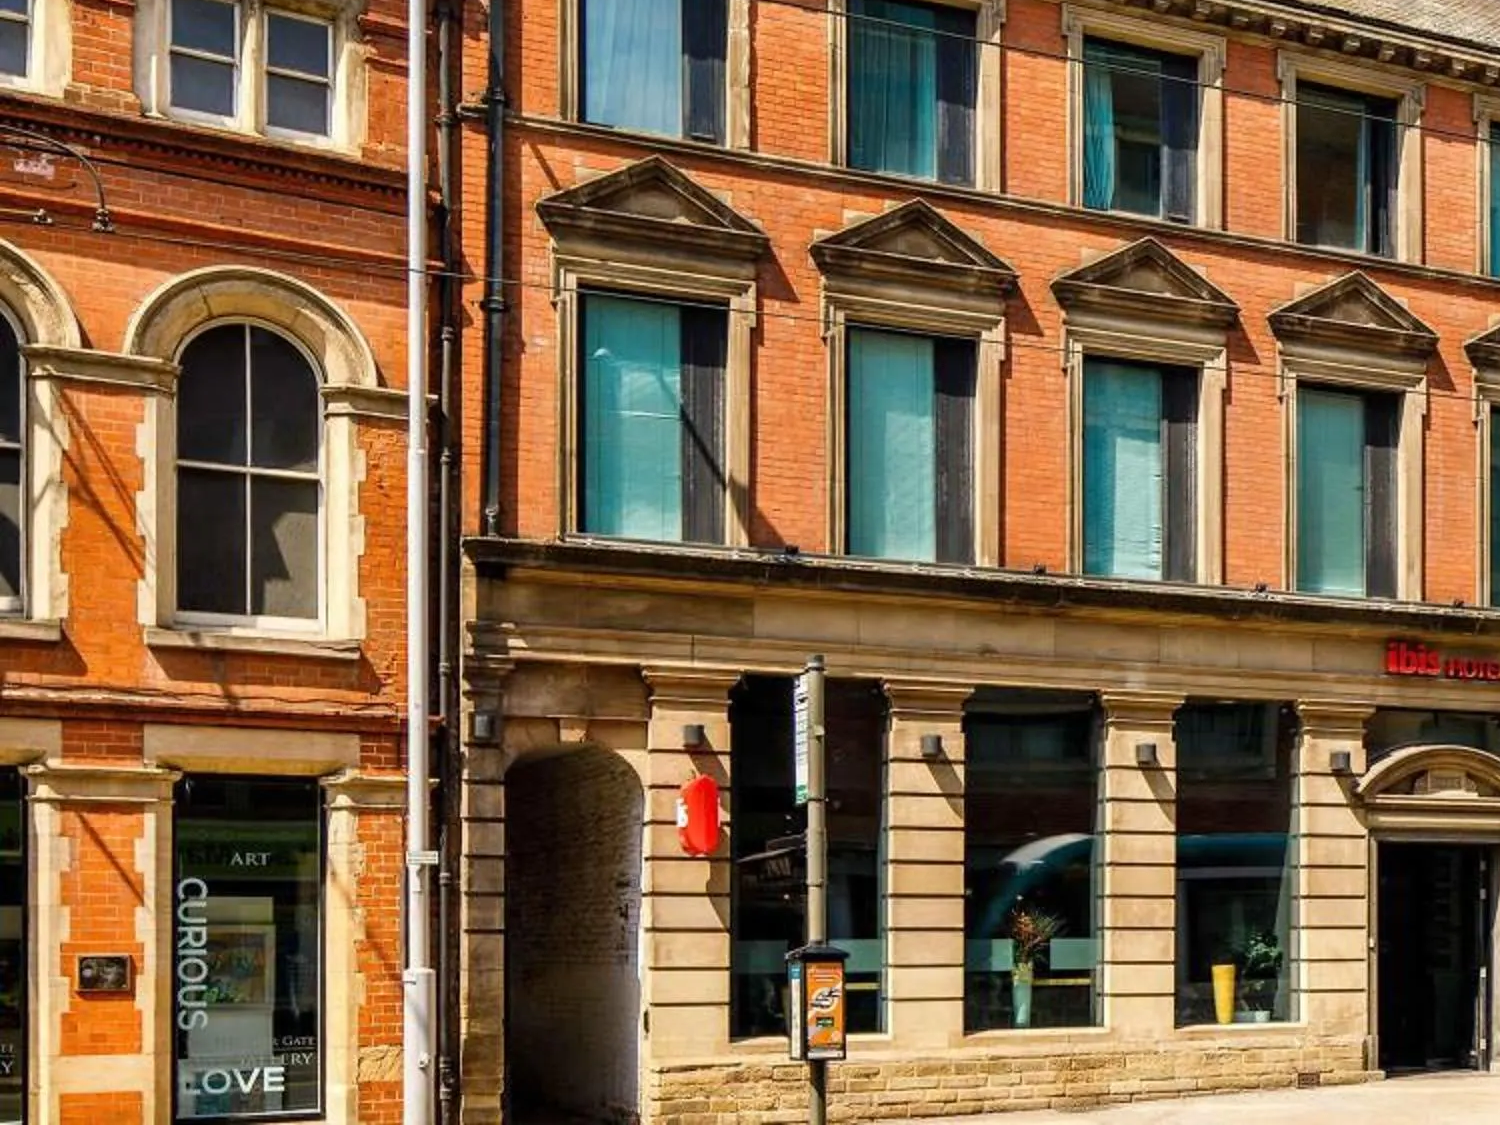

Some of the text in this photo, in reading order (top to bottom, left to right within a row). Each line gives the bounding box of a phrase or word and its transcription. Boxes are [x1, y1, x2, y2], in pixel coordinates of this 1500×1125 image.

[1386, 641, 1441, 674] ibis
[230, 852, 272, 866] ART
[176, 877, 209, 1032] CURIOUS
